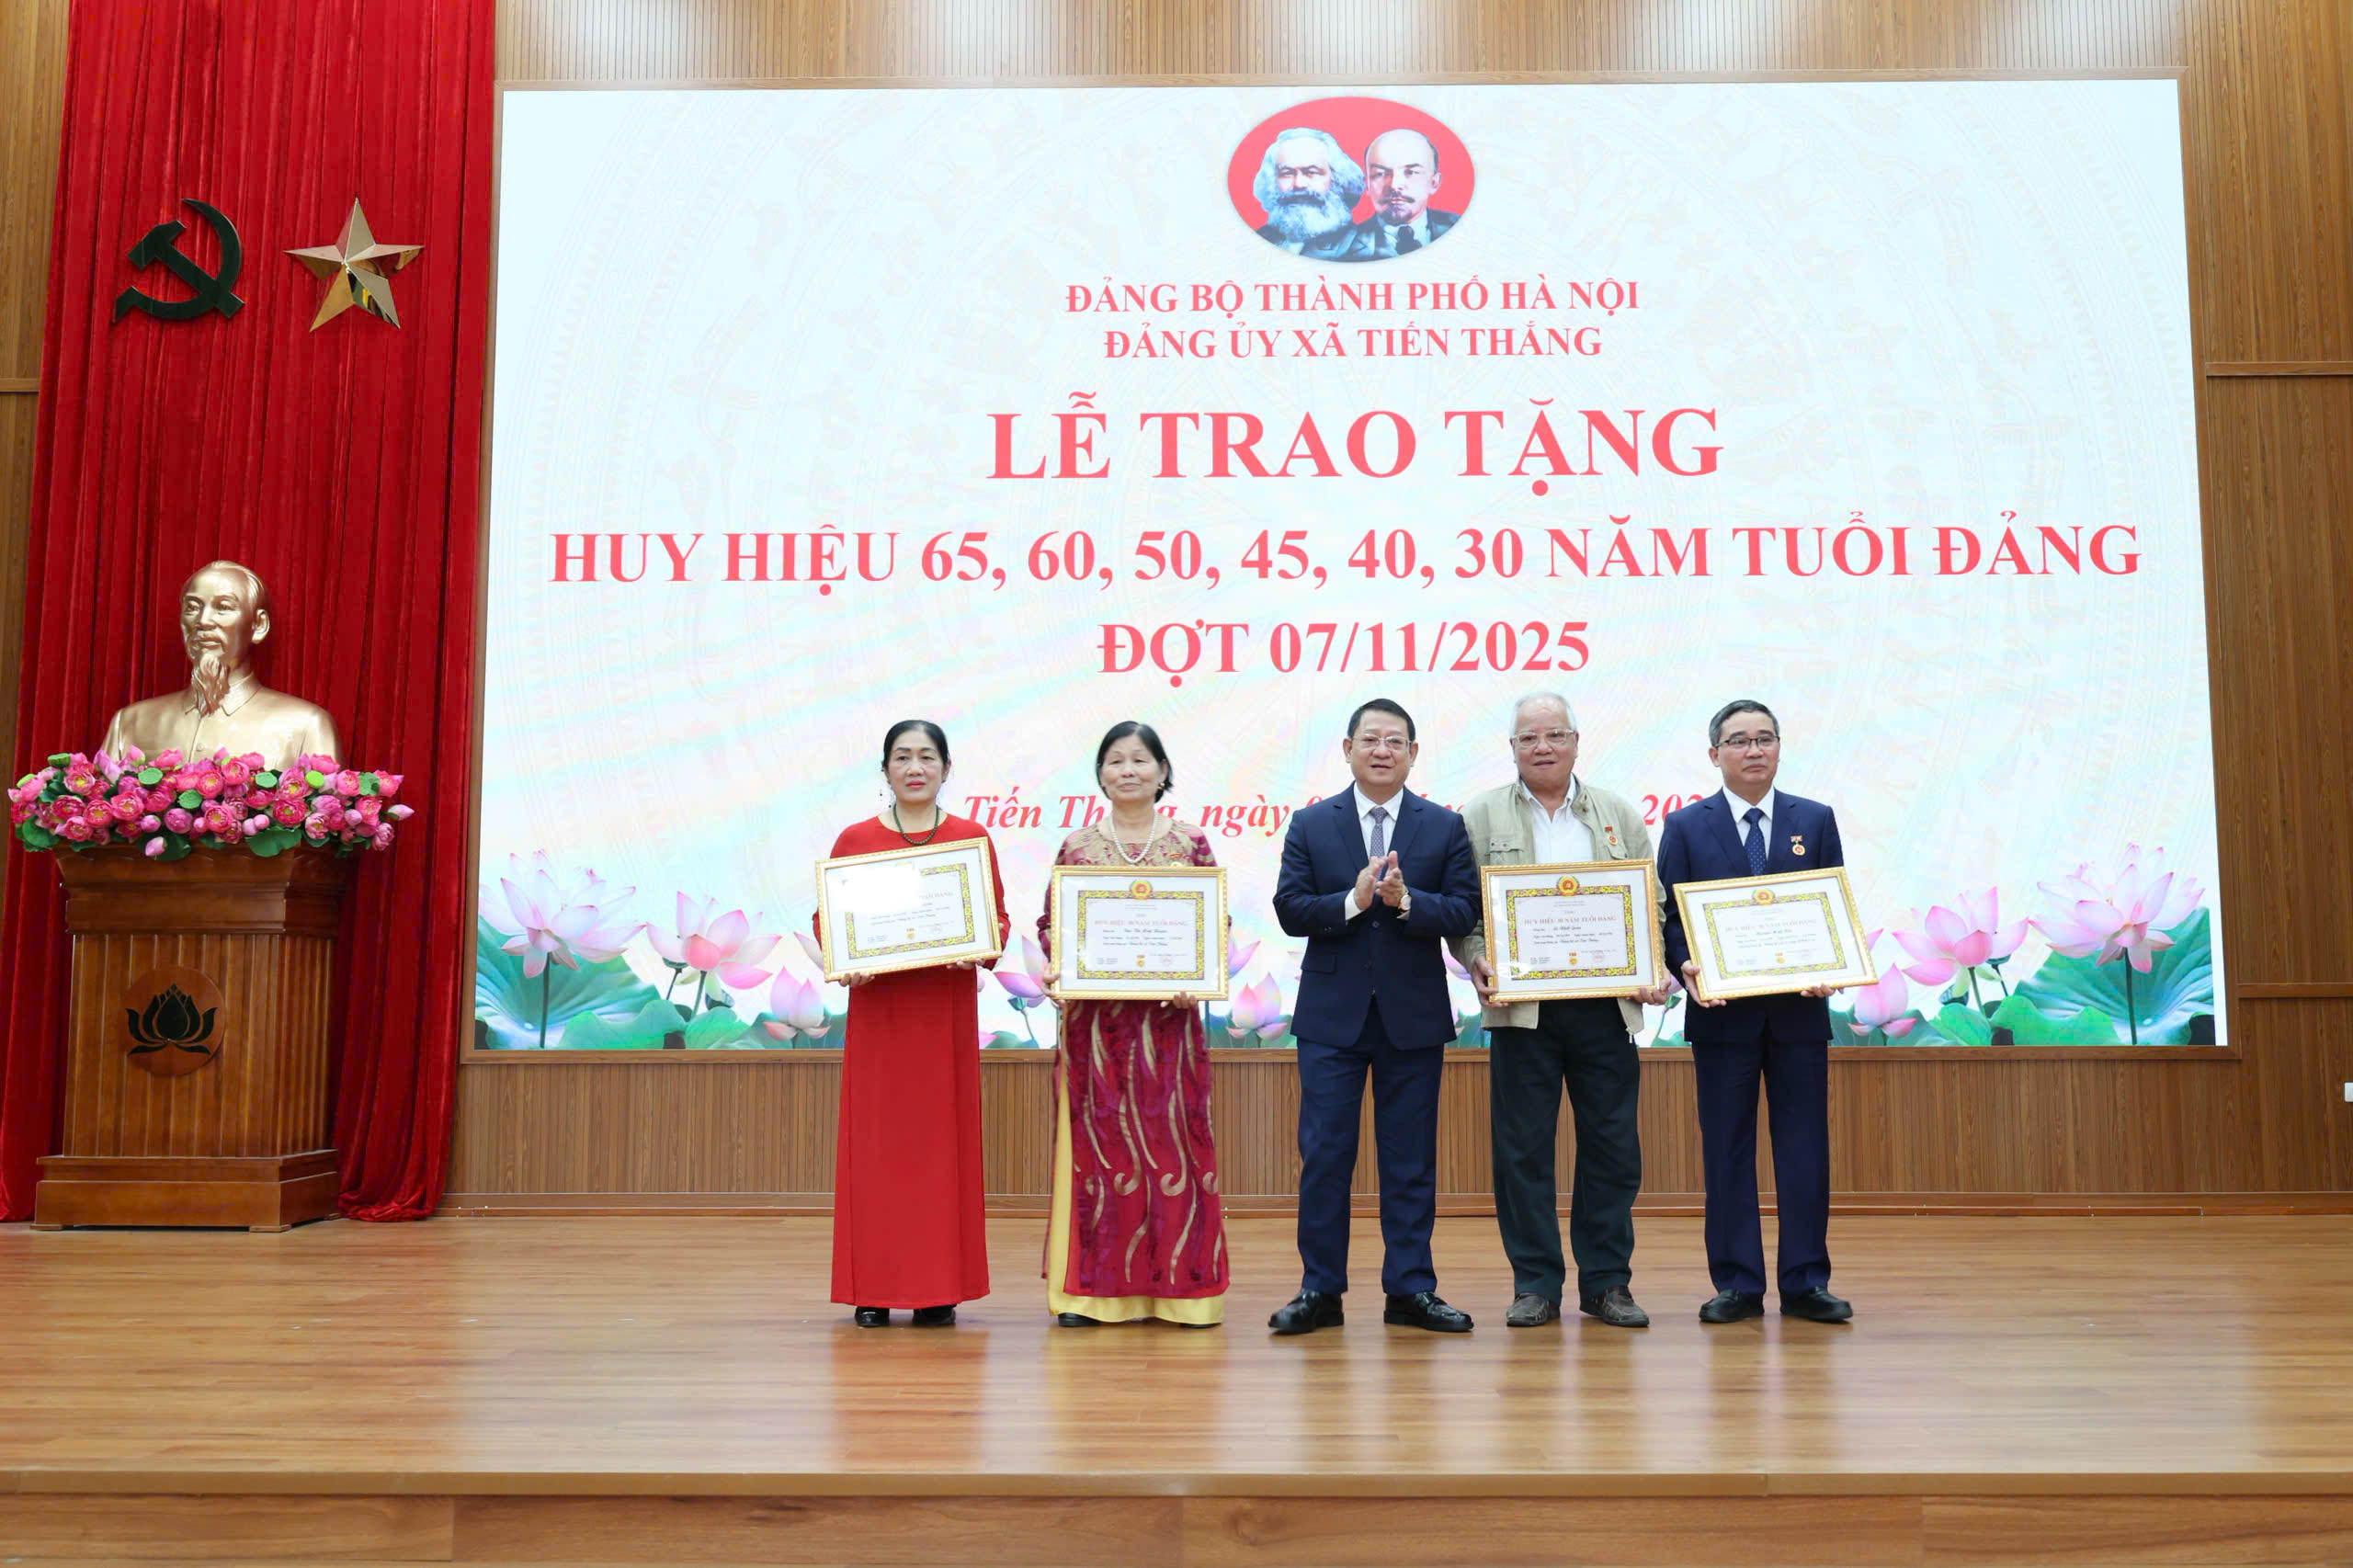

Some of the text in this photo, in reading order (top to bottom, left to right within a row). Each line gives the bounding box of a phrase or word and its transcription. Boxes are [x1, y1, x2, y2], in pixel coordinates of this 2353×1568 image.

[1065, 273, 1641, 319] ĐẢNG BỘ THÀNH PHỐ HÀ NỘI
[1104, 320, 1603, 358] ĐẢNG ỦY XÃ TIẾN THẮNG
[986, 392, 1724, 496] LỄ TRAO TẶNG
[549, 510, 2143, 597] HUY HIỆU 65, 60, 50, 45, 40, 30 NĂM TUỔI ĐẢNG
[1097, 619, 1590, 688] ĐỢT 07/11/2025
[964, 786, 1042, 828] Tiến
[1200, 794, 1290, 837] ngày
[1642, 793, 1704, 826] 20
